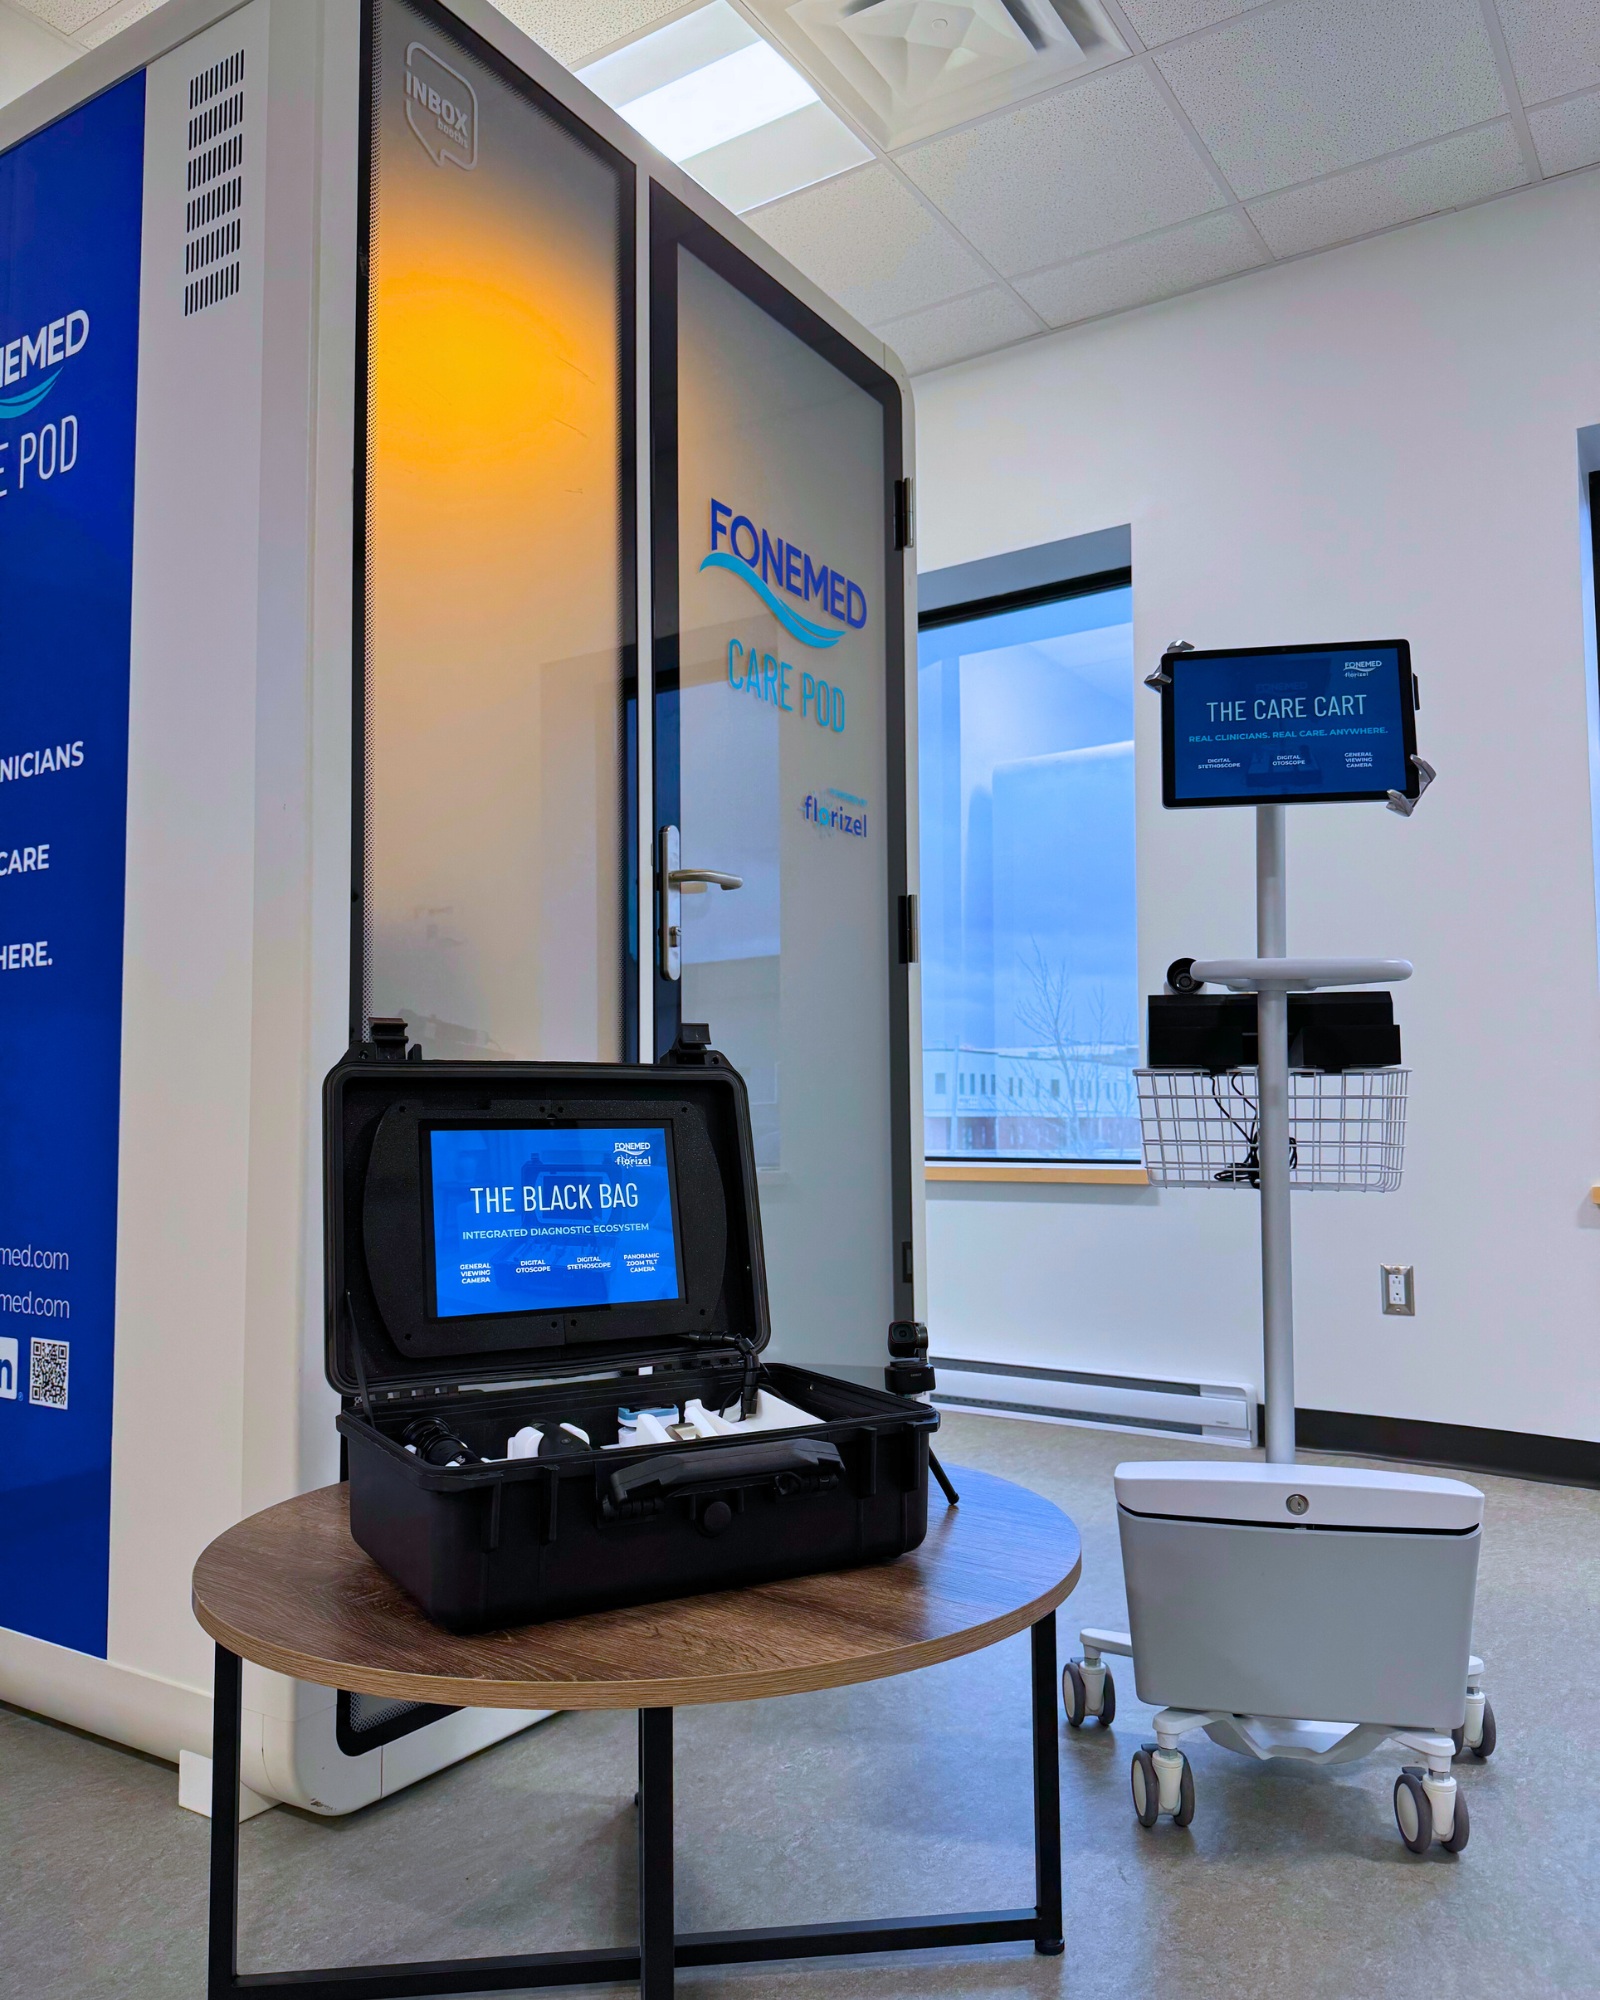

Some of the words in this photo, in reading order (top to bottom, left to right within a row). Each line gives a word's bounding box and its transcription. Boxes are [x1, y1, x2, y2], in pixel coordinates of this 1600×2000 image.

[406, 71, 468, 137] INBOX
[19, 414, 78, 489] POD
[710, 497, 867, 630] FONEMED
[1344, 660, 1382, 669] FONEMED
[728, 638, 794, 713] CARE
[802, 672, 846, 734] POD
[1206, 701, 1247, 722] THE
[1253, 697, 1307, 720] CARE
[1314, 694, 1367, 717] CART
[1188, 735, 1213, 743] REAL
[1215, 731, 1271, 742] CLINICIANS.
[1272, 730, 1297, 739] REAL
[1299, 728, 1328, 738] CARE.
[1329, 726, 1389, 737] ANYWHERE.
[804, 795, 867, 838] florizel
[0, 844, 50, 876] CARE
[614, 1142, 651, 1150] FONEMED
[616, 1155, 652, 1166] florizel
[470, 1187, 515, 1213] THE
[523, 1184, 593, 1212] BLACK
[599, 1182, 639, 1209] BAG
[462, 1228, 528, 1240] INTEGRATED
[530, 1225, 591, 1237] DIAGNOSTIC
[593, 1222, 650, 1233] ECOSYSTEM
[459, 1262, 492, 1270] GENERAL
[566, 1262, 612, 1270] STETHOSCOPE
[623, 1252, 660, 1260] PANORAMIC
